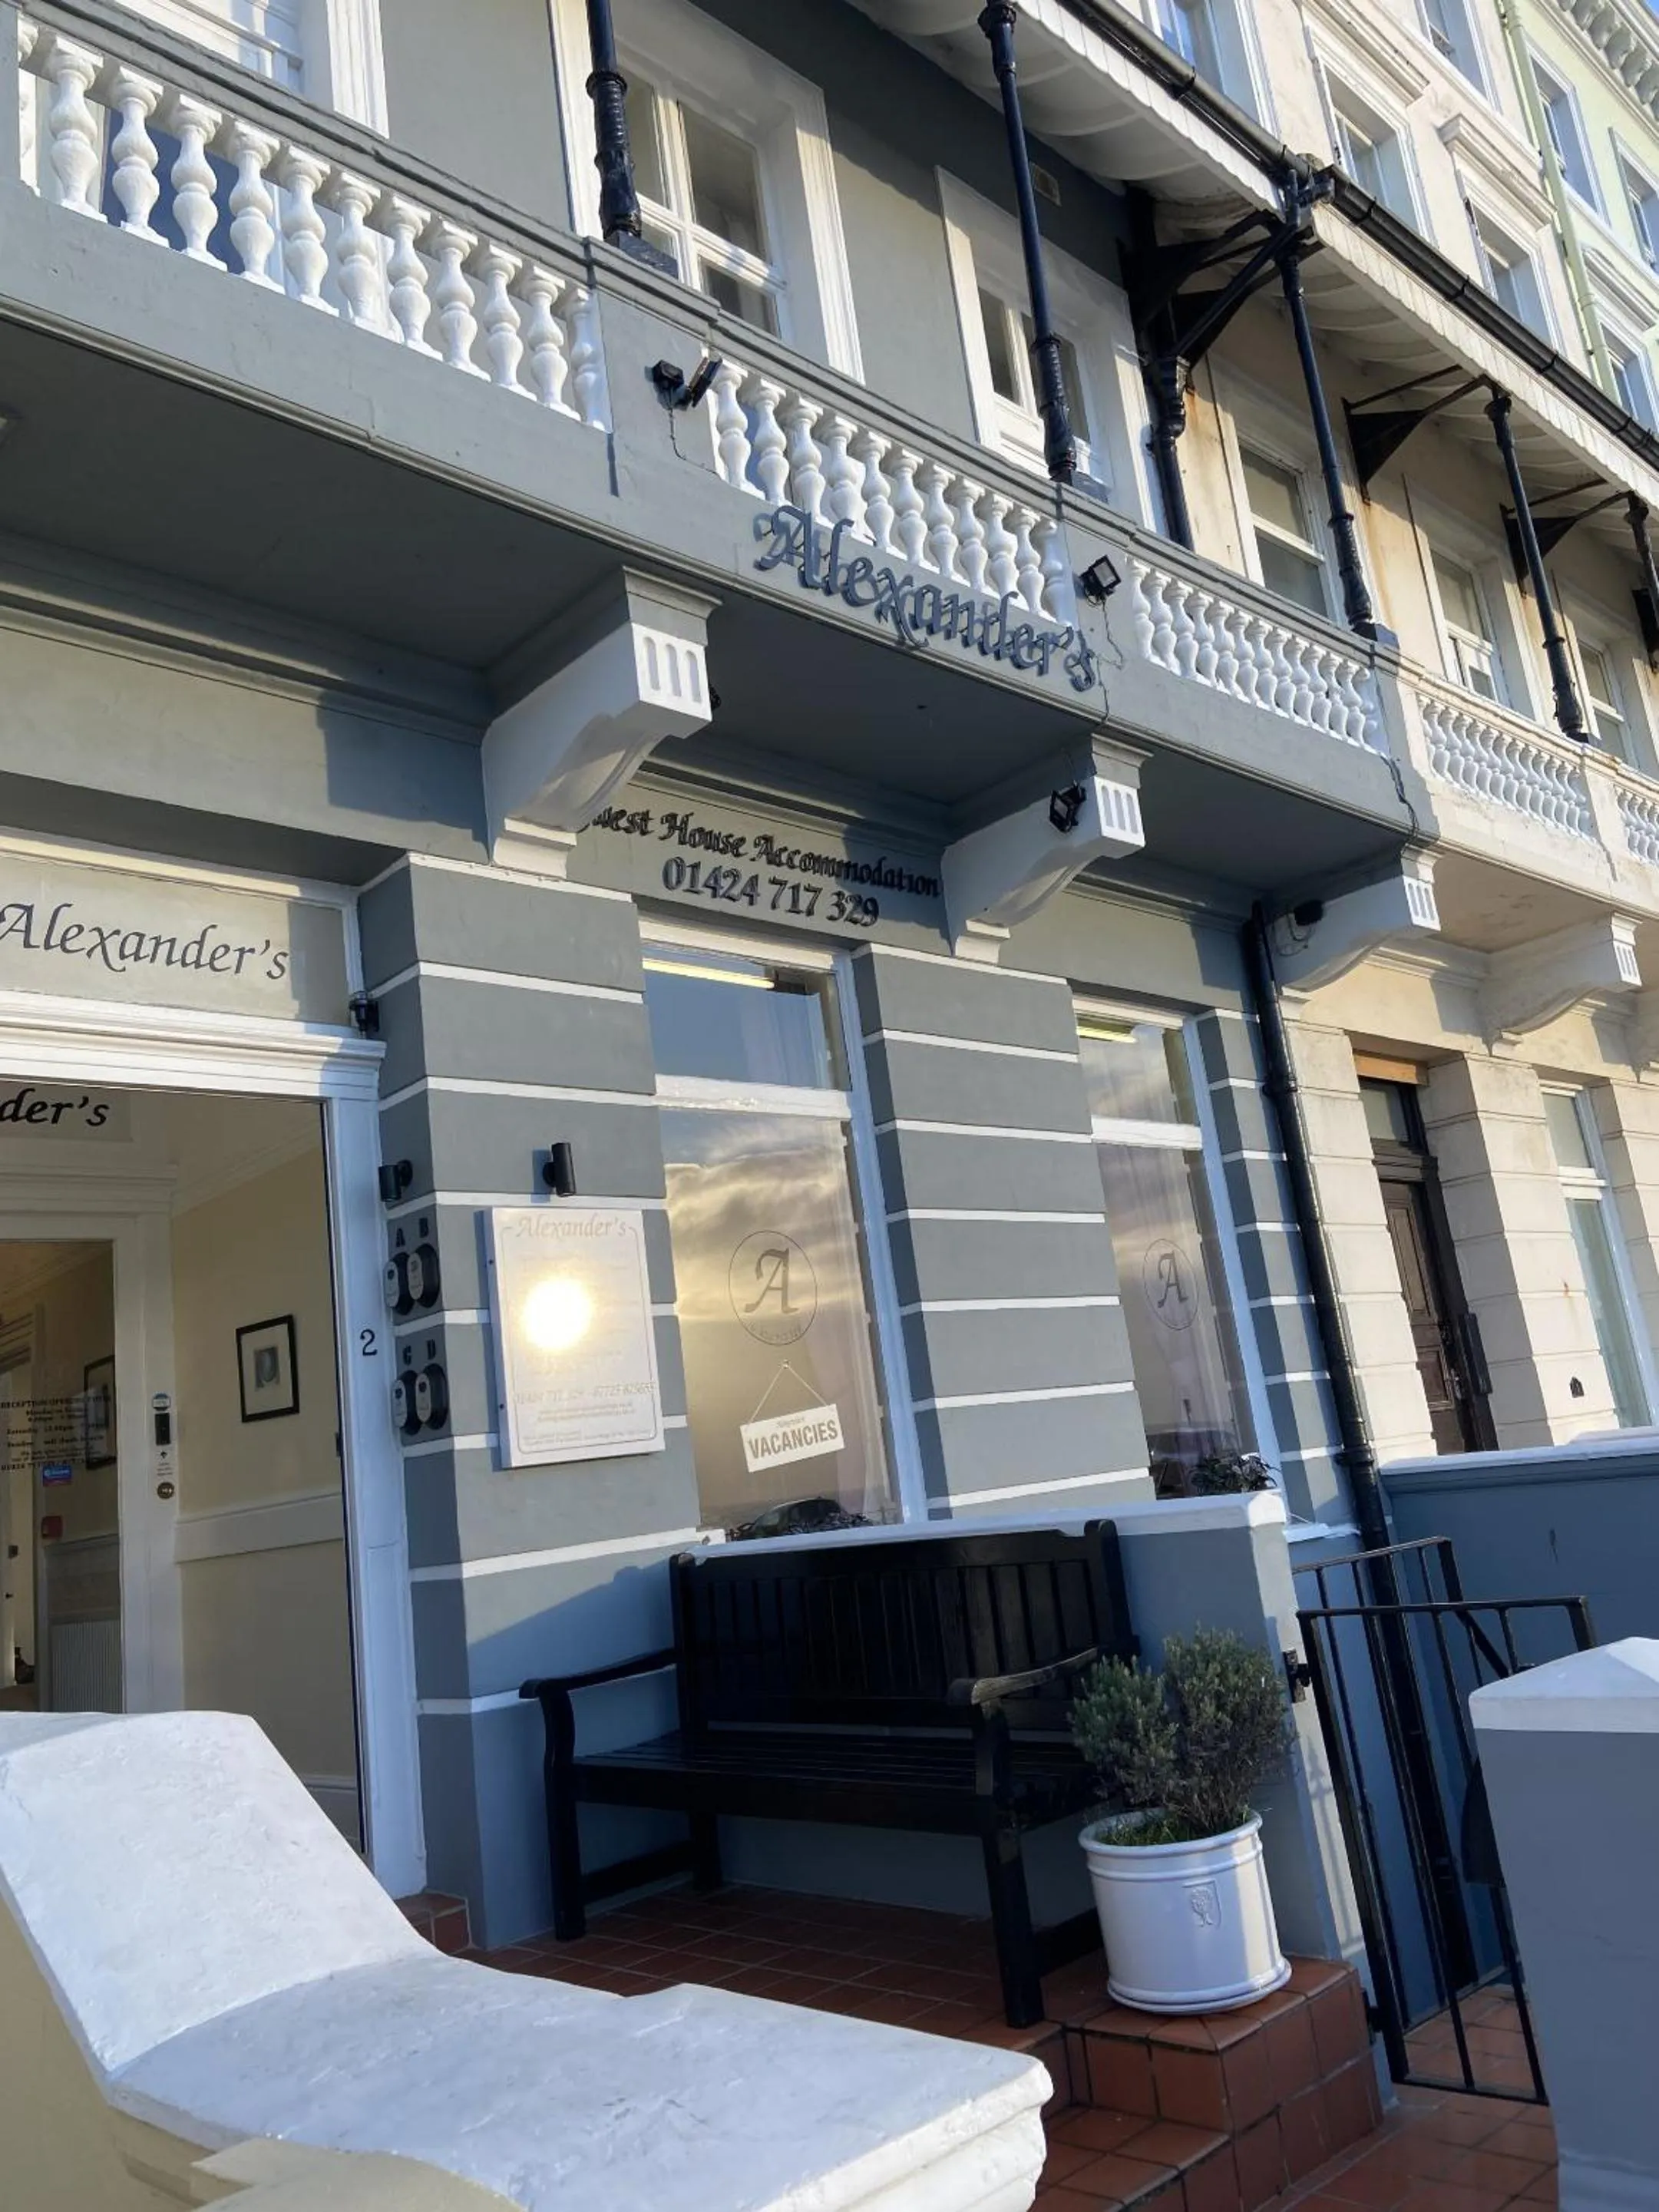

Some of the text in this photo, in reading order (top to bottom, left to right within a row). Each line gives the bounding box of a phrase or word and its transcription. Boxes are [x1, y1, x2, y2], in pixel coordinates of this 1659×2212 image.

[591, 805, 940, 897] uest House Accommodation
[662, 856, 879, 927] 01424 717 329
[0, 903, 289, 980] Alexander's
[744, 1248, 800, 1314] A
[1157, 1250, 1189, 1309] A
[360, 1329, 378, 1356] 2
[749, 1419, 838, 1459] VACANCIES
